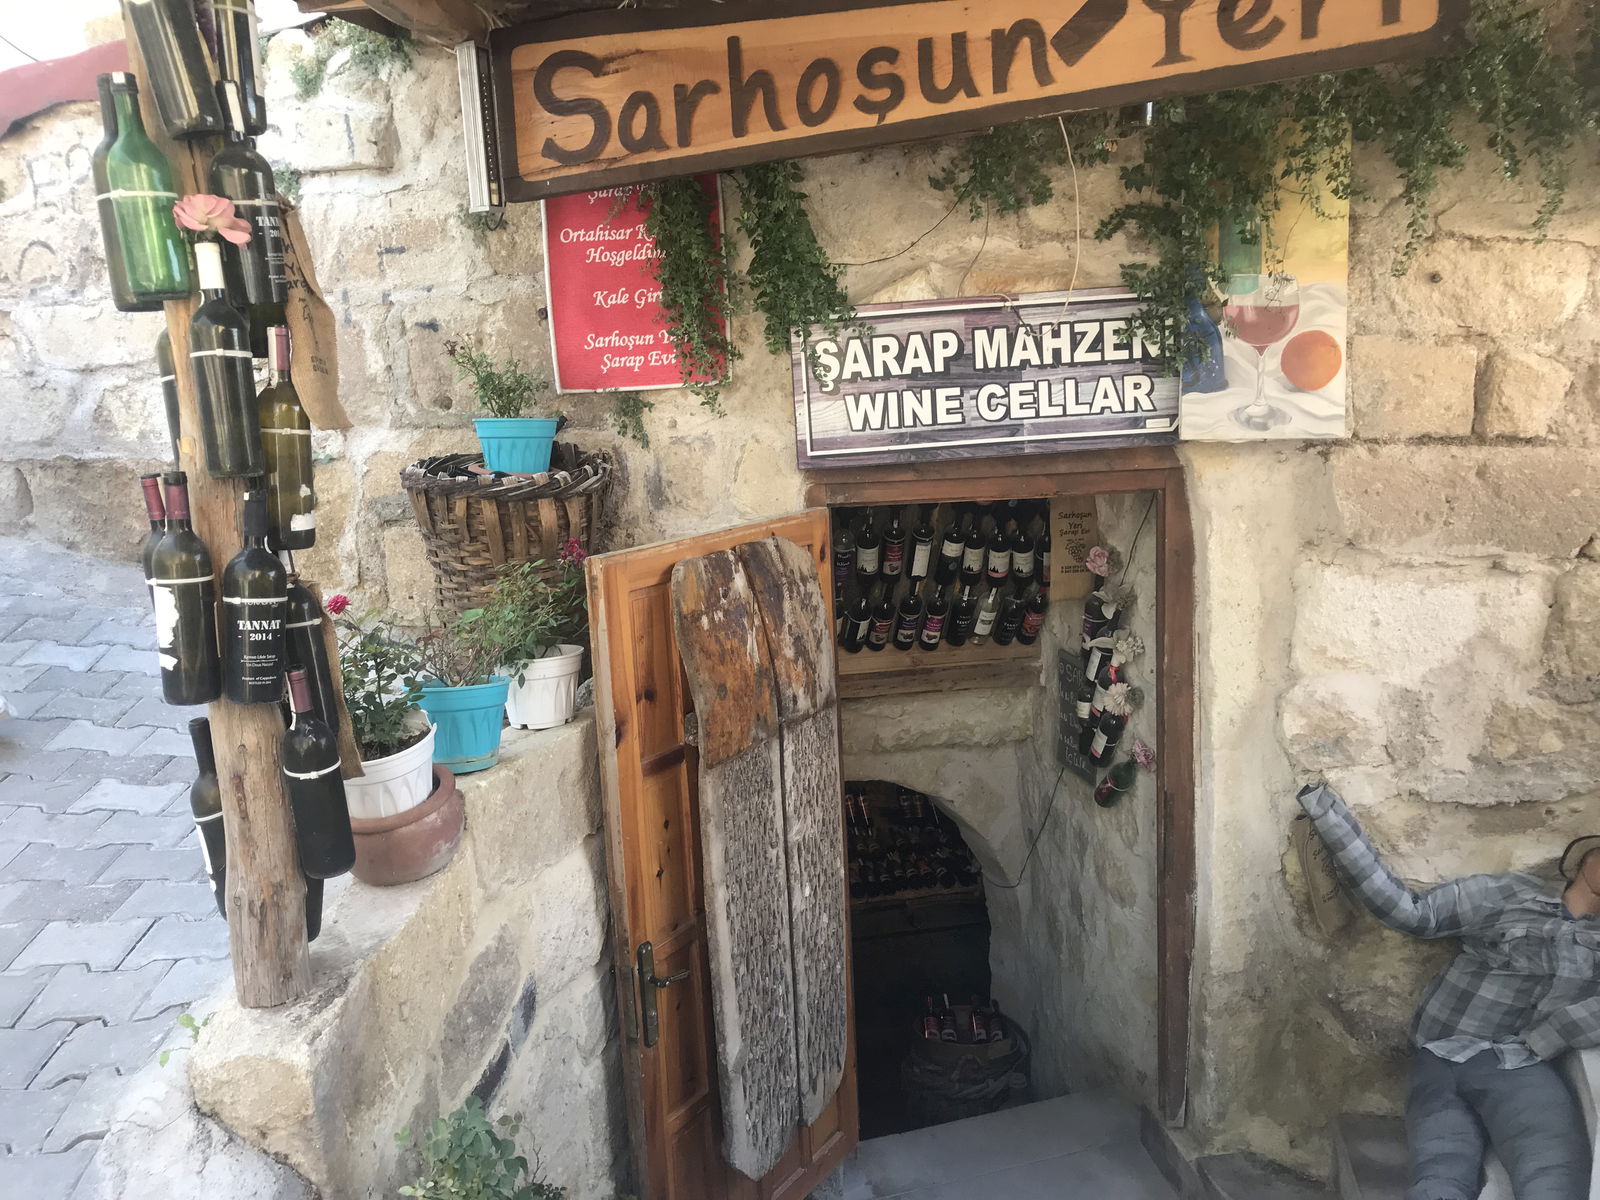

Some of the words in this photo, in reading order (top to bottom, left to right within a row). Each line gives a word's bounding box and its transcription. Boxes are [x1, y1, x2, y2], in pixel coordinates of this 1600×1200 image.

[533, 18, 1056, 165] Sarhoşun
[560, 224, 631, 244] Ortahisar
[593, 287, 629, 308] Kale
[584, 330, 654, 351] Sarhoşun
[600, 353, 645, 374] Şarap
[648, 349, 677, 368] Evi
[814, 332, 959, 392] ŞARAP
[844, 386, 964, 432] WINE
[976, 375, 1156, 422] CELLAR
[237, 620, 281, 631] TANNAT
[249, 633, 272, 641] 2014
